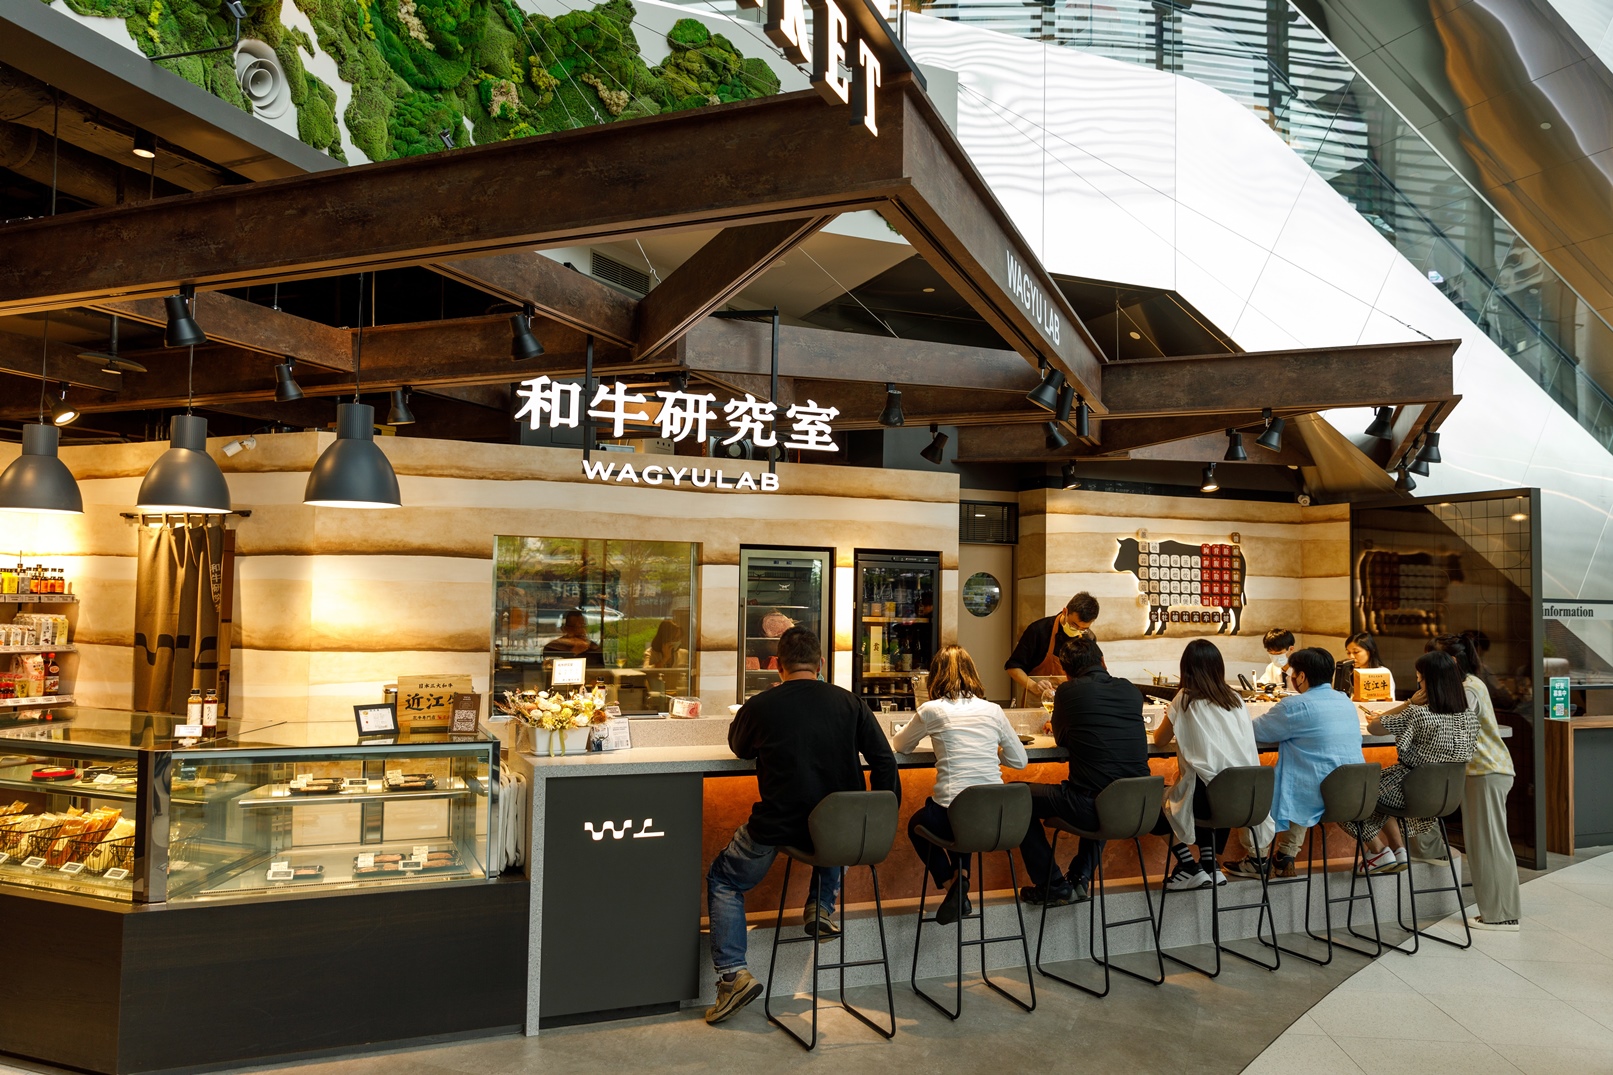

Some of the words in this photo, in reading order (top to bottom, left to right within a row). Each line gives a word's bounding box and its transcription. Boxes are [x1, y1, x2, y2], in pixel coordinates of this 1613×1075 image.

[1006, 249, 1042, 325] WAGYU
[1044, 299, 1060, 346] LAB
[514, 375, 841, 452] 和牛研究室
[582, 459, 780, 491] WAGYULAB
[1542, 605, 1594, 617] information
[1363, 680, 1388, 691] 近江牛
